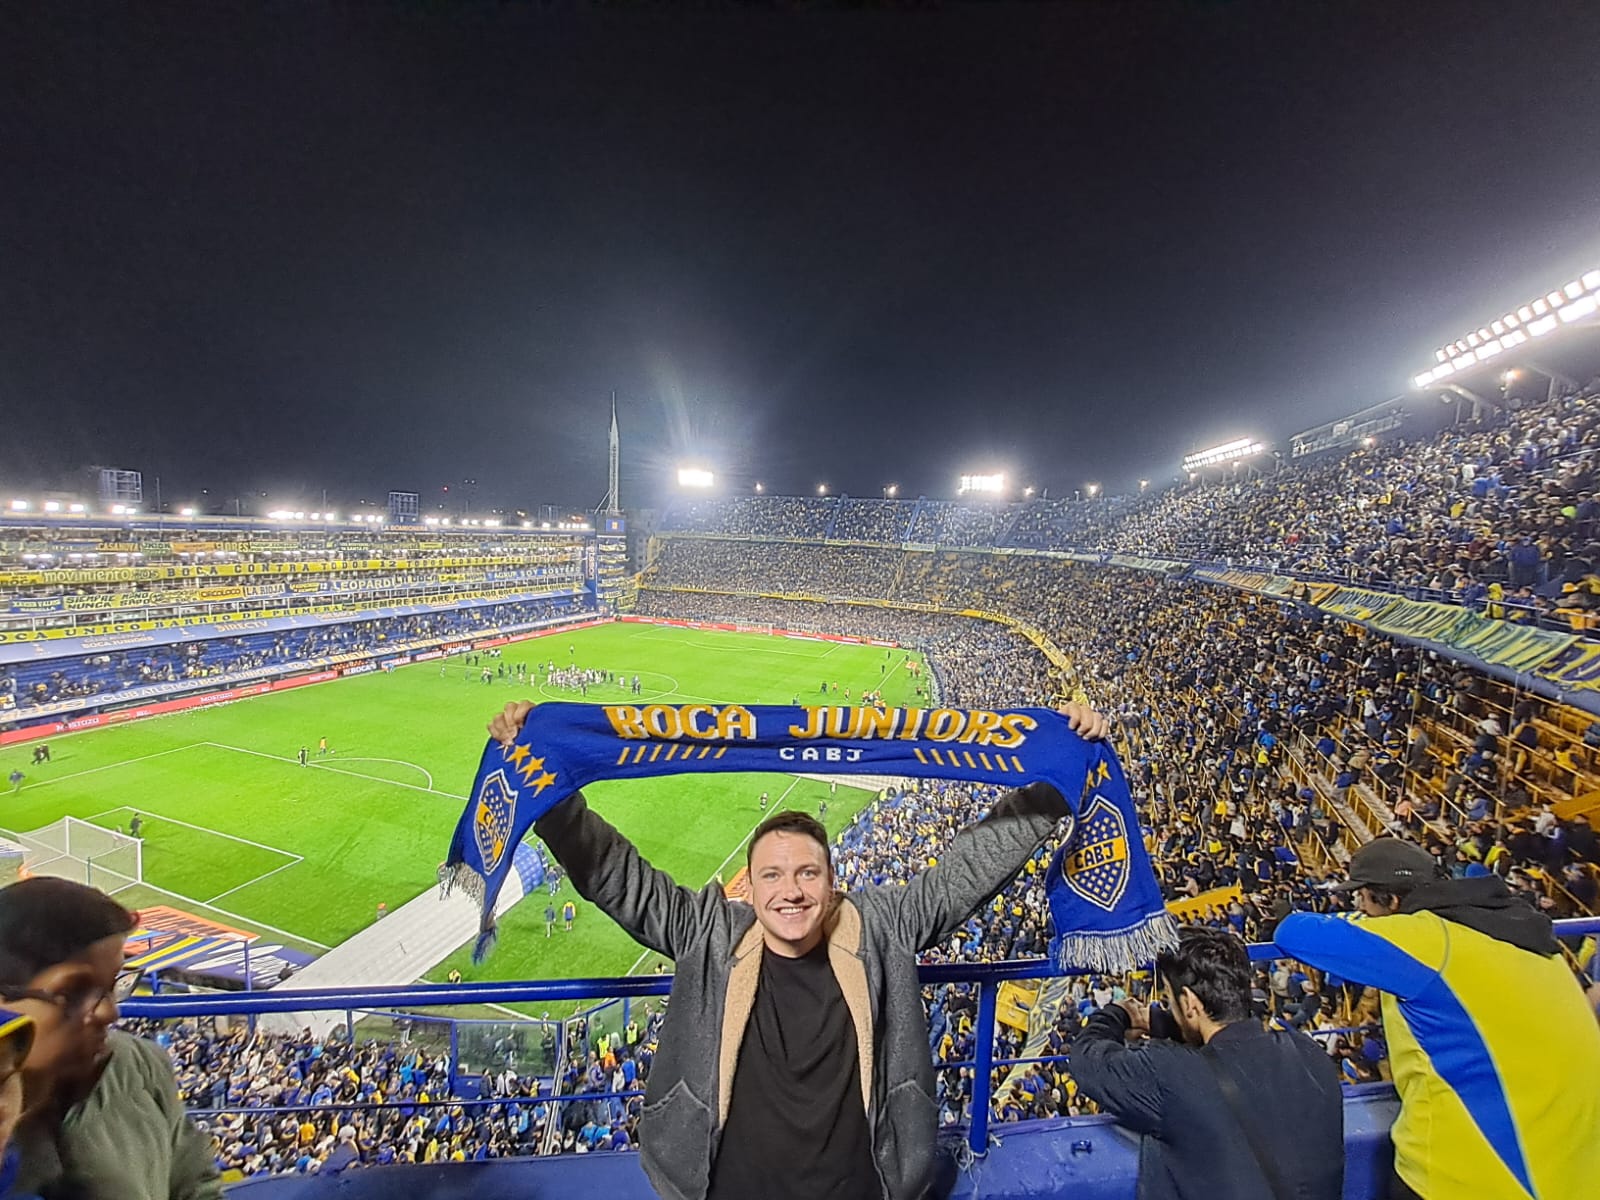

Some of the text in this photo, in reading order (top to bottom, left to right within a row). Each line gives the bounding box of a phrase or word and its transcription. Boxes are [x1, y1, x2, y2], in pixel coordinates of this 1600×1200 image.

[44, 568, 131, 583] movimiento
[167, 566, 218, 577] BOCA
[234, 563, 310, 574] CONTRA
[321, 561, 368, 570] TODOS
[521, 568, 538, 576] SOY
[246, 586, 258, 597] LA
[260, 584, 285, 595] RIOJA
[333, 579, 395, 591] LEOPARDI
[65, 594, 115, 604] SIEMPRE
[67, 602, 112, 610] NUNCA
[361, 598, 410, 610] SIEMPRE
[412, 594, 450, 604] ESTARE
[65, 623, 141, 636] UNICO
[154, 614, 231, 628] BARRIO
[242, 611, 264, 621] DE
[273, 603, 340, 617] PRIMERA
[101, 690, 139, 702] CLUB
[601, 704, 1039, 749] BOCA JUNIORS
[779, 747, 863, 761] CABJ
[1074, 842, 1114, 870] CABJ
